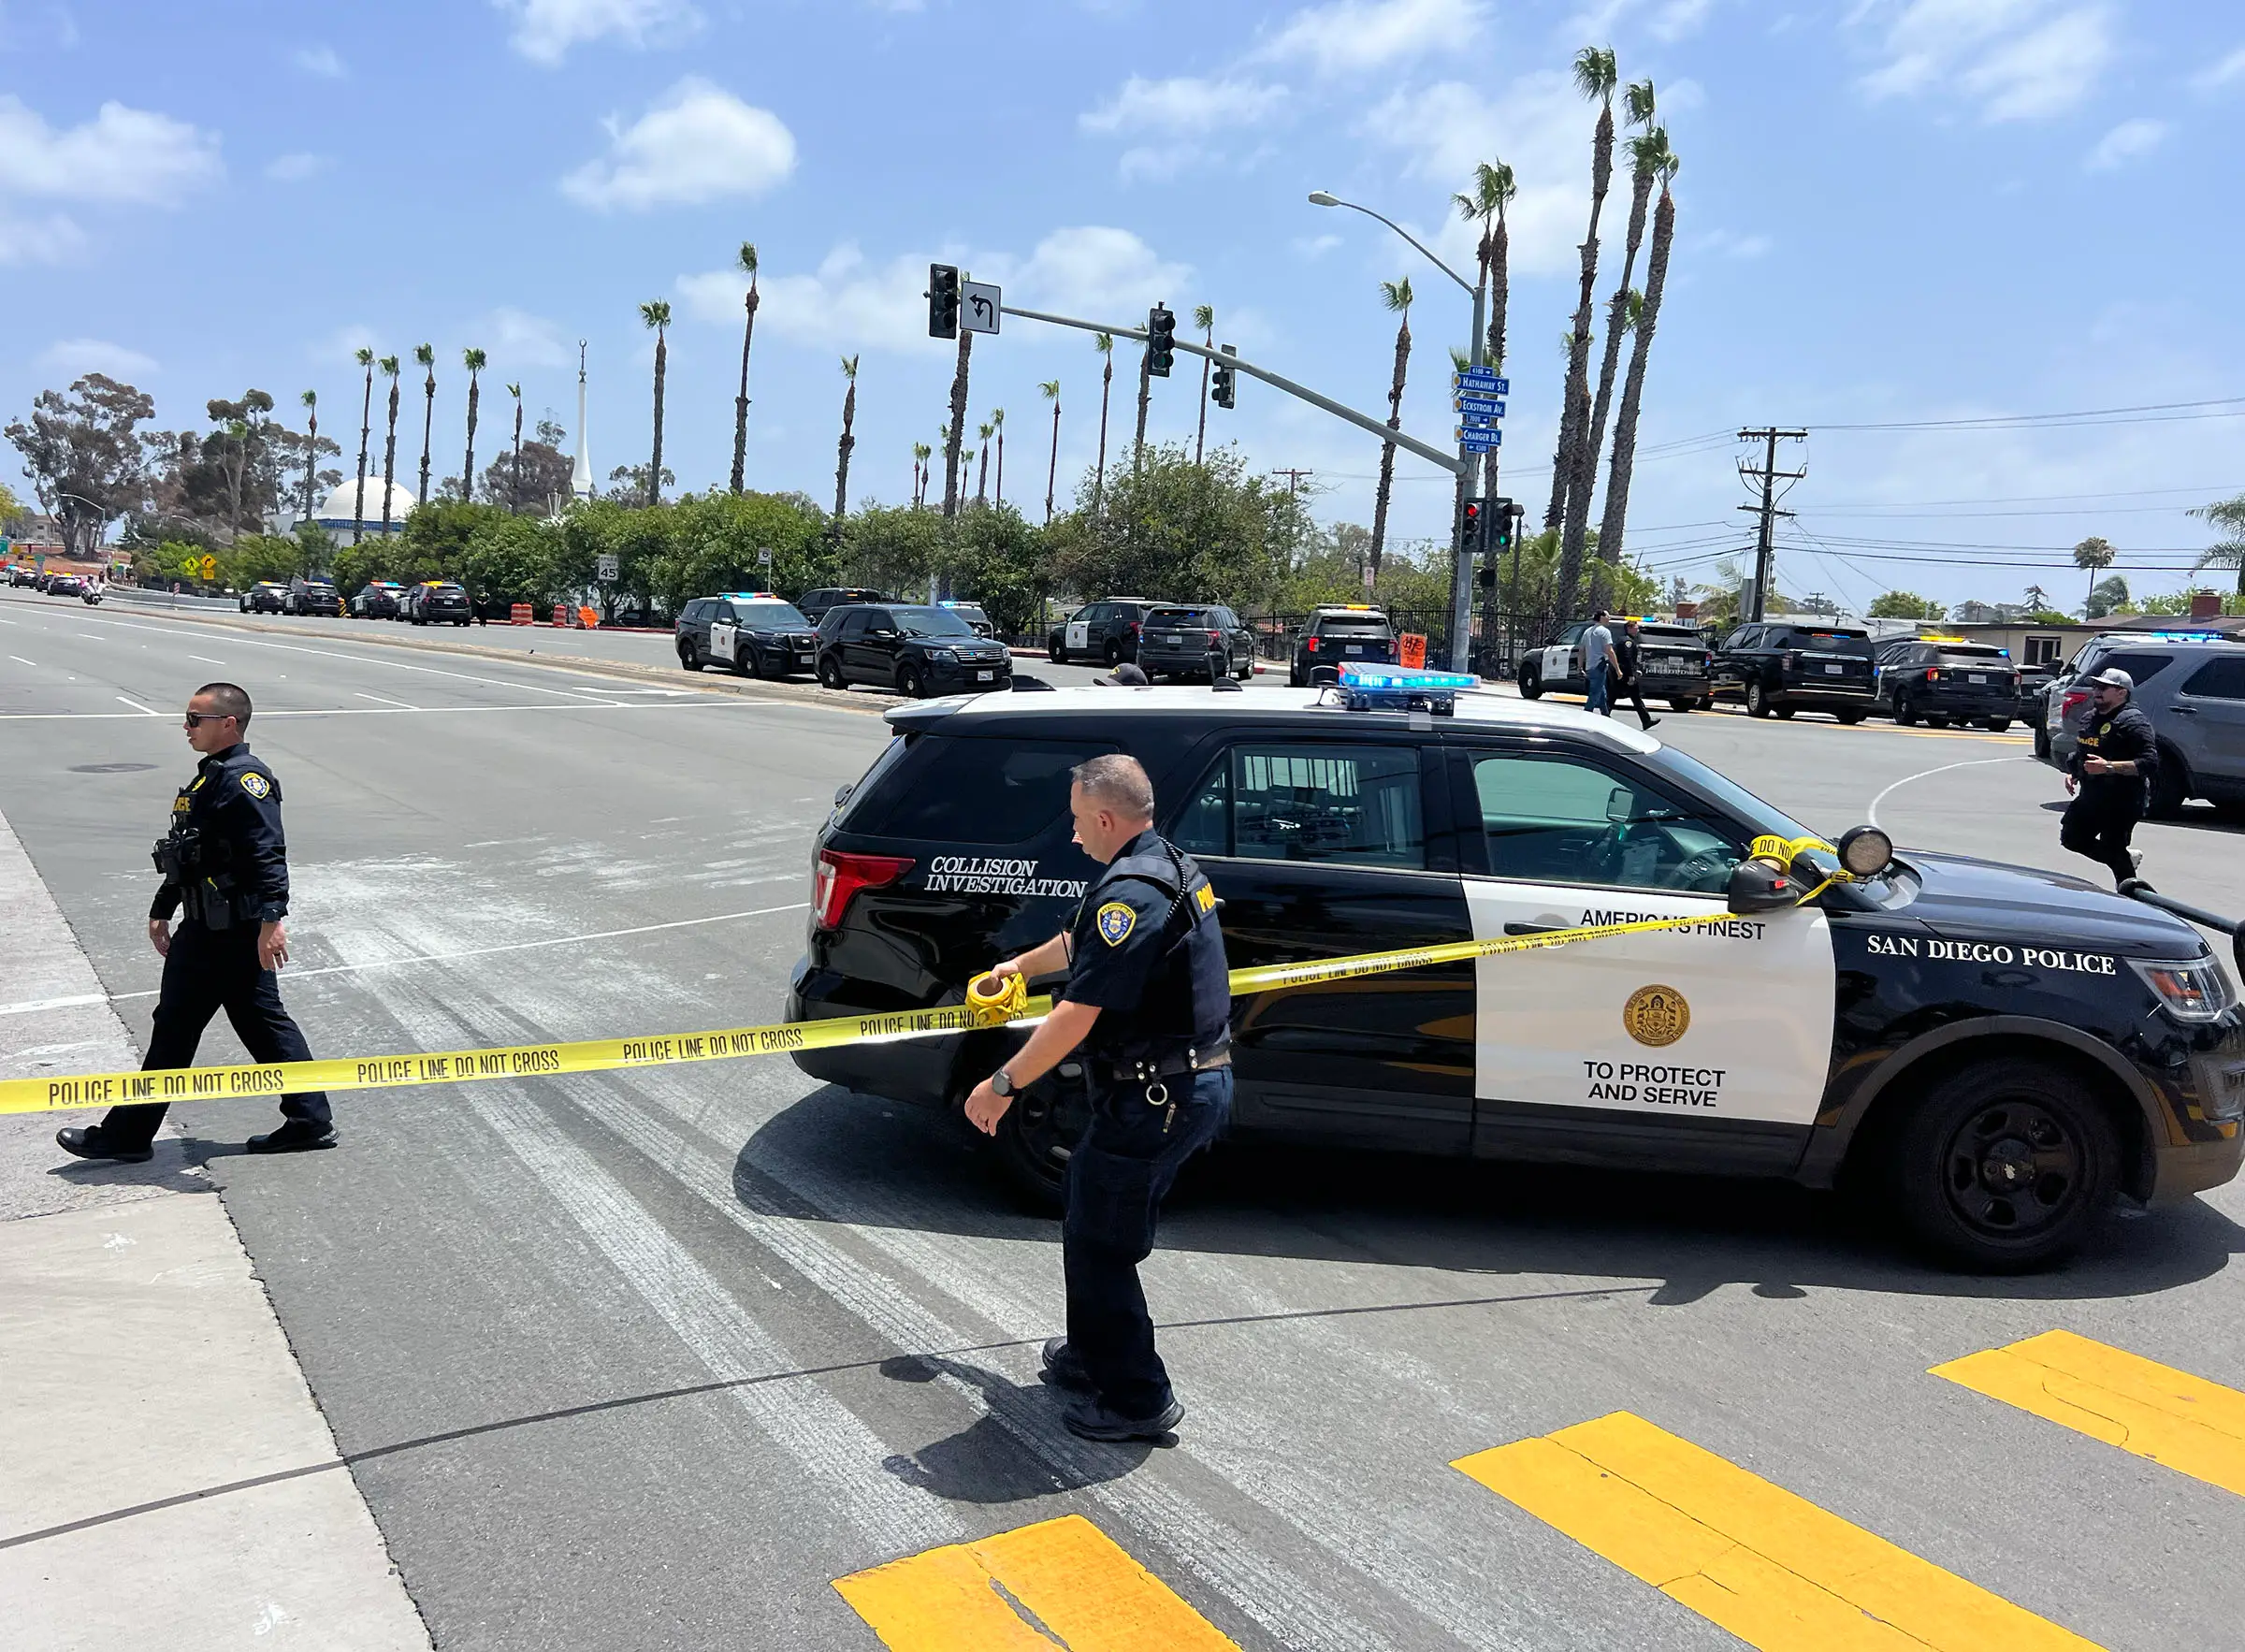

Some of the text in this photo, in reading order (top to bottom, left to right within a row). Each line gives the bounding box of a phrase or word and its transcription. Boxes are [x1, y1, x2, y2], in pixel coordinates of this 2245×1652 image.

[1462, 377, 1496, 390] HATHAWAY
[1462, 400, 1493, 413] ECKSTROM
[1463, 429, 1490, 442] CHARGER
[600, 568, 616, 578] 45
[1759, 839, 1774, 853] DO
[930, 856, 1038, 877] COLLISION
[923, 874, 1088, 898] INVESTIGATION
[1697, 920, 1766, 940] FINEST
[1867, 935, 2117, 975] SAN DIEGO POLICE
[861, 1016, 905, 1036] POLICE
[939, 1010, 955, 1028] DO
[624, 1028, 804, 1064] POLICE LINE DO NOT CROSS
[357, 1050, 558, 1083] POLICE LINE DO NOT CROSS
[1584, 1061, 1726, 1087] TO PROTECT
[49, 1068, 284, 1107] POLICE LINE DO NOT CROSS
[1587, 1082, 1718, 1108] AND SERVE
